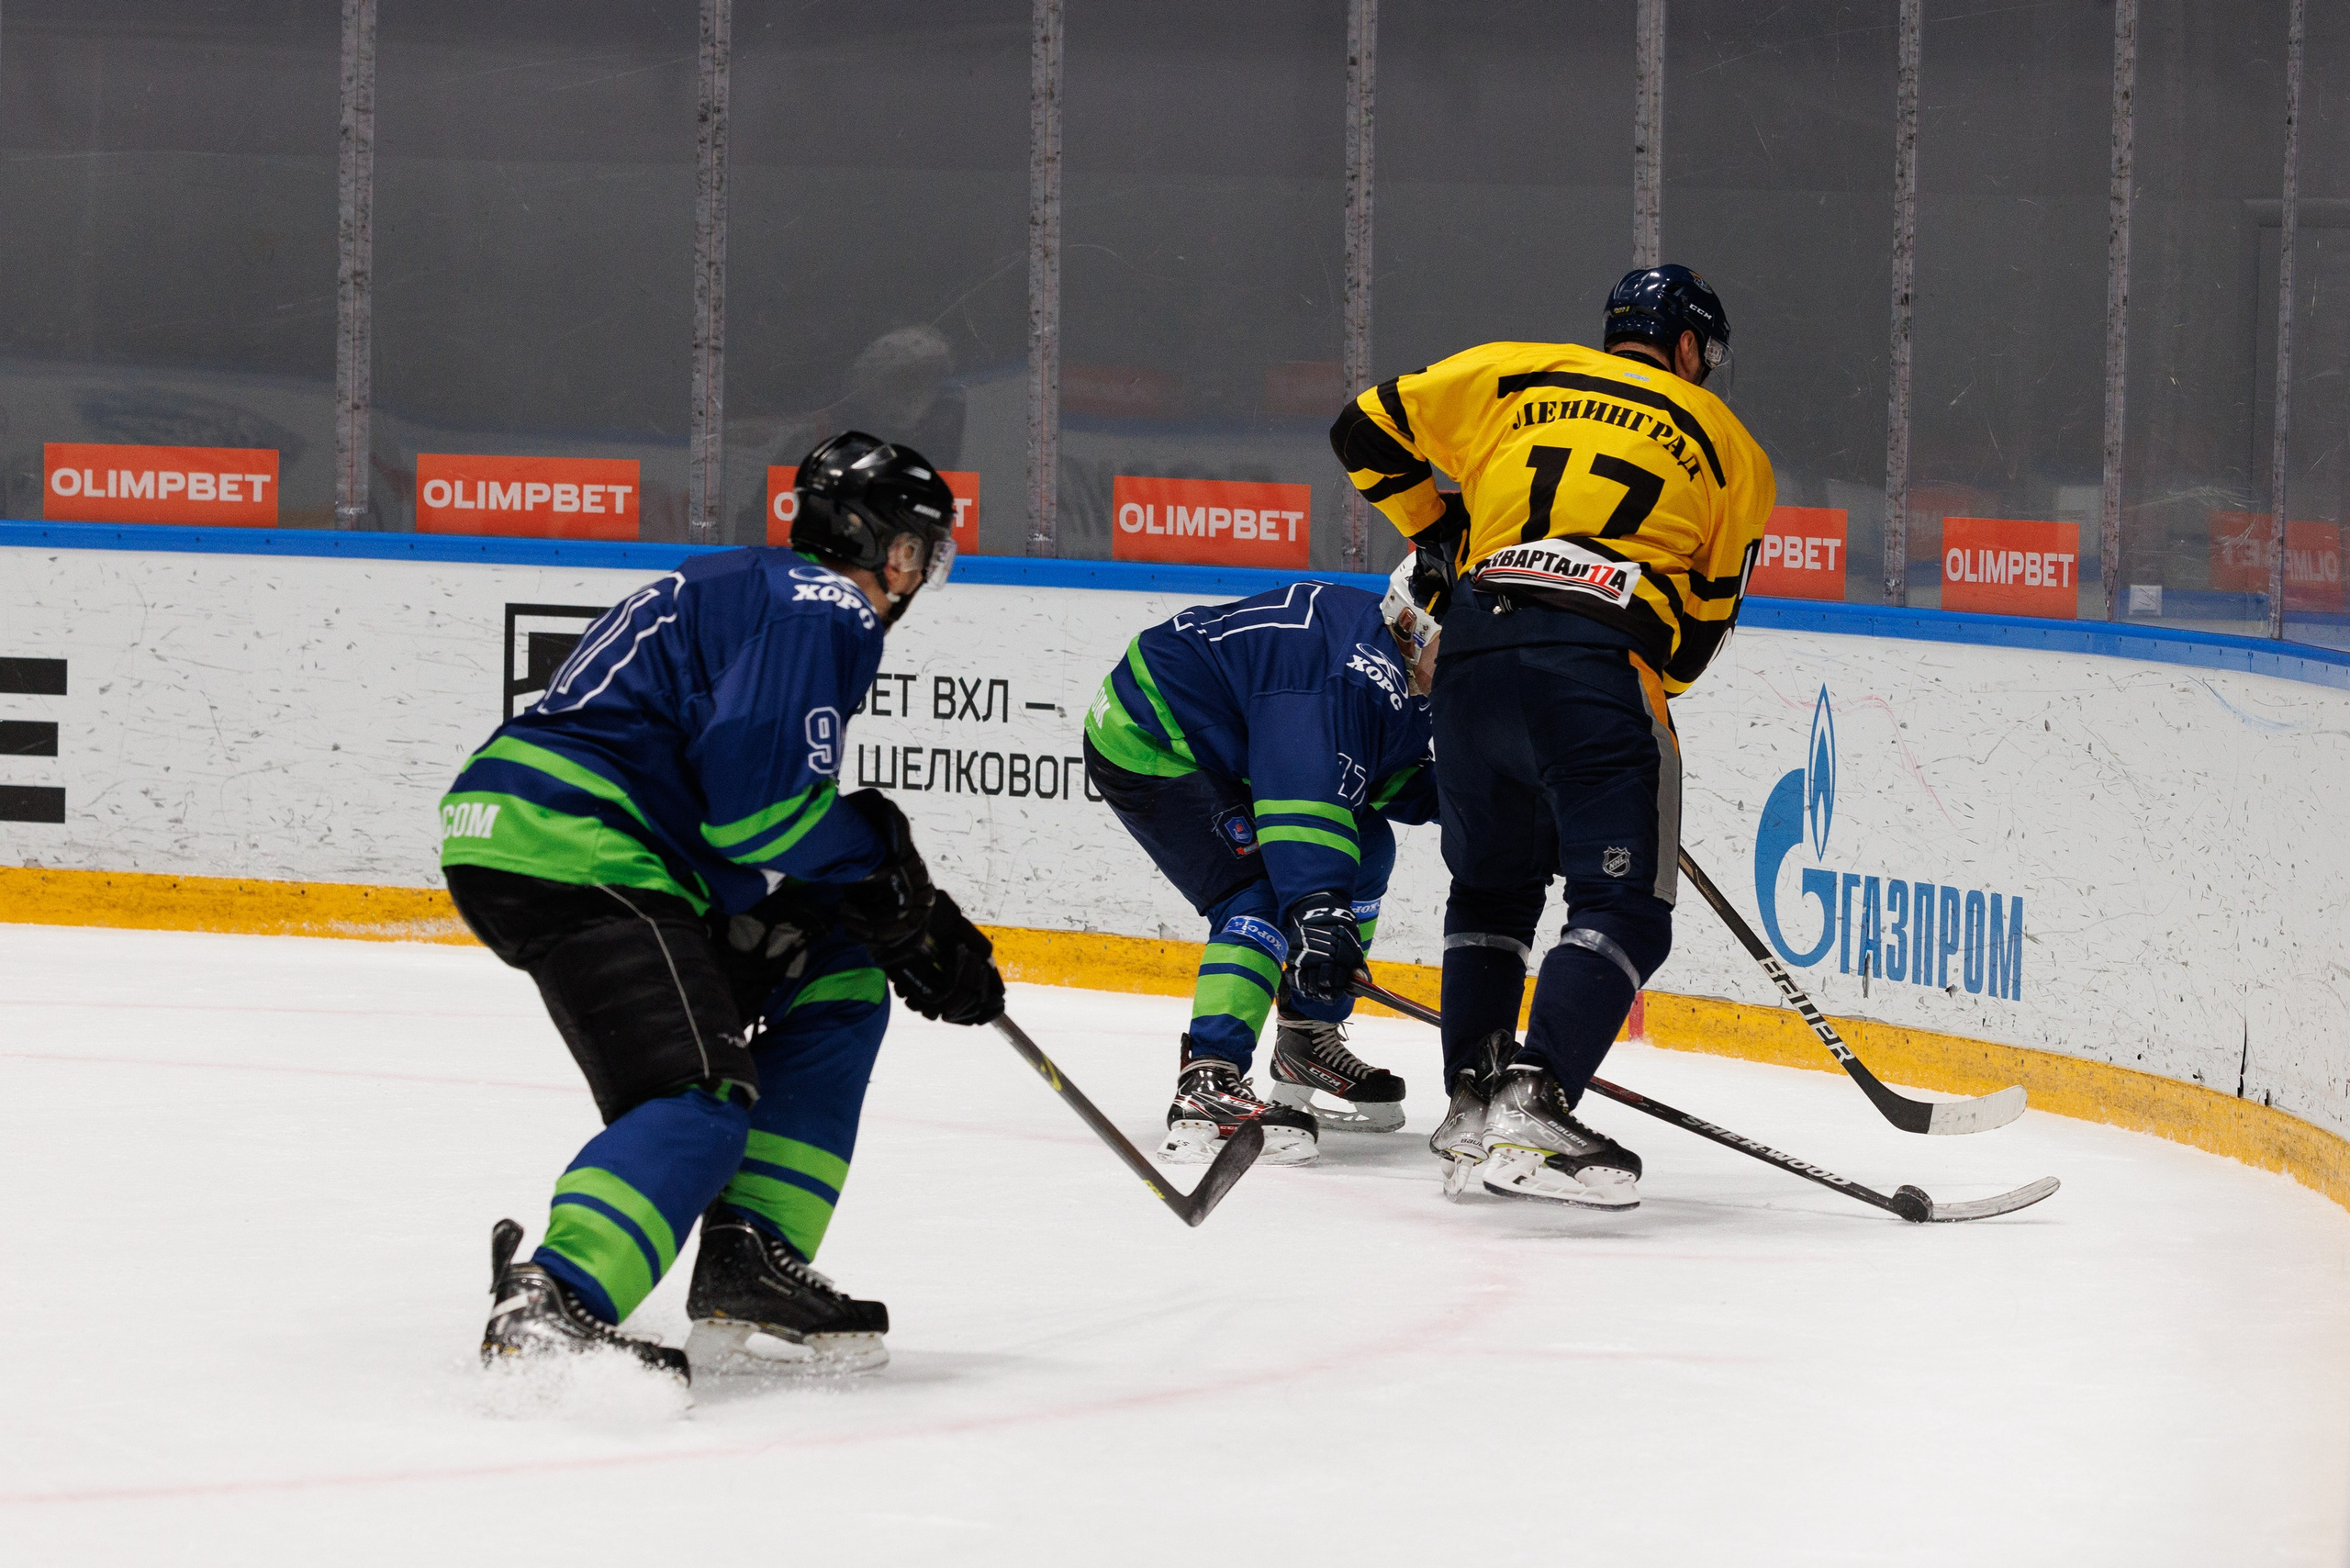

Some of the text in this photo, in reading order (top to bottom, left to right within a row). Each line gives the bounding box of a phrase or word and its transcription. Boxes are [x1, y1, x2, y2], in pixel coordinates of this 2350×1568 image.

[1689, 303, 1713, 320] CCM
[1512, 398, 1701, 483] ЛЕНИНГРАД
[50, 467, 272, 503] OLIMPBET
[422, 478, 633, 515] OLIMPBET
[1516, 444, 1666, 543] 17
[1118, 502, 1304, 542] OLIMPBET
[1755, 534, 1841, 571] PBET
[1945, 547, 2075, 588] OLIMPBET
[933, 676, 1009, 723] ВХЛ
[1346, 654, 1404, 711] ХОРС
[1608, 856, 1626, 871] NHL
[1839, 872, 2023, 1002] ГАЗПРОМ
[1307, 1066, 1341, 1087] CCM
